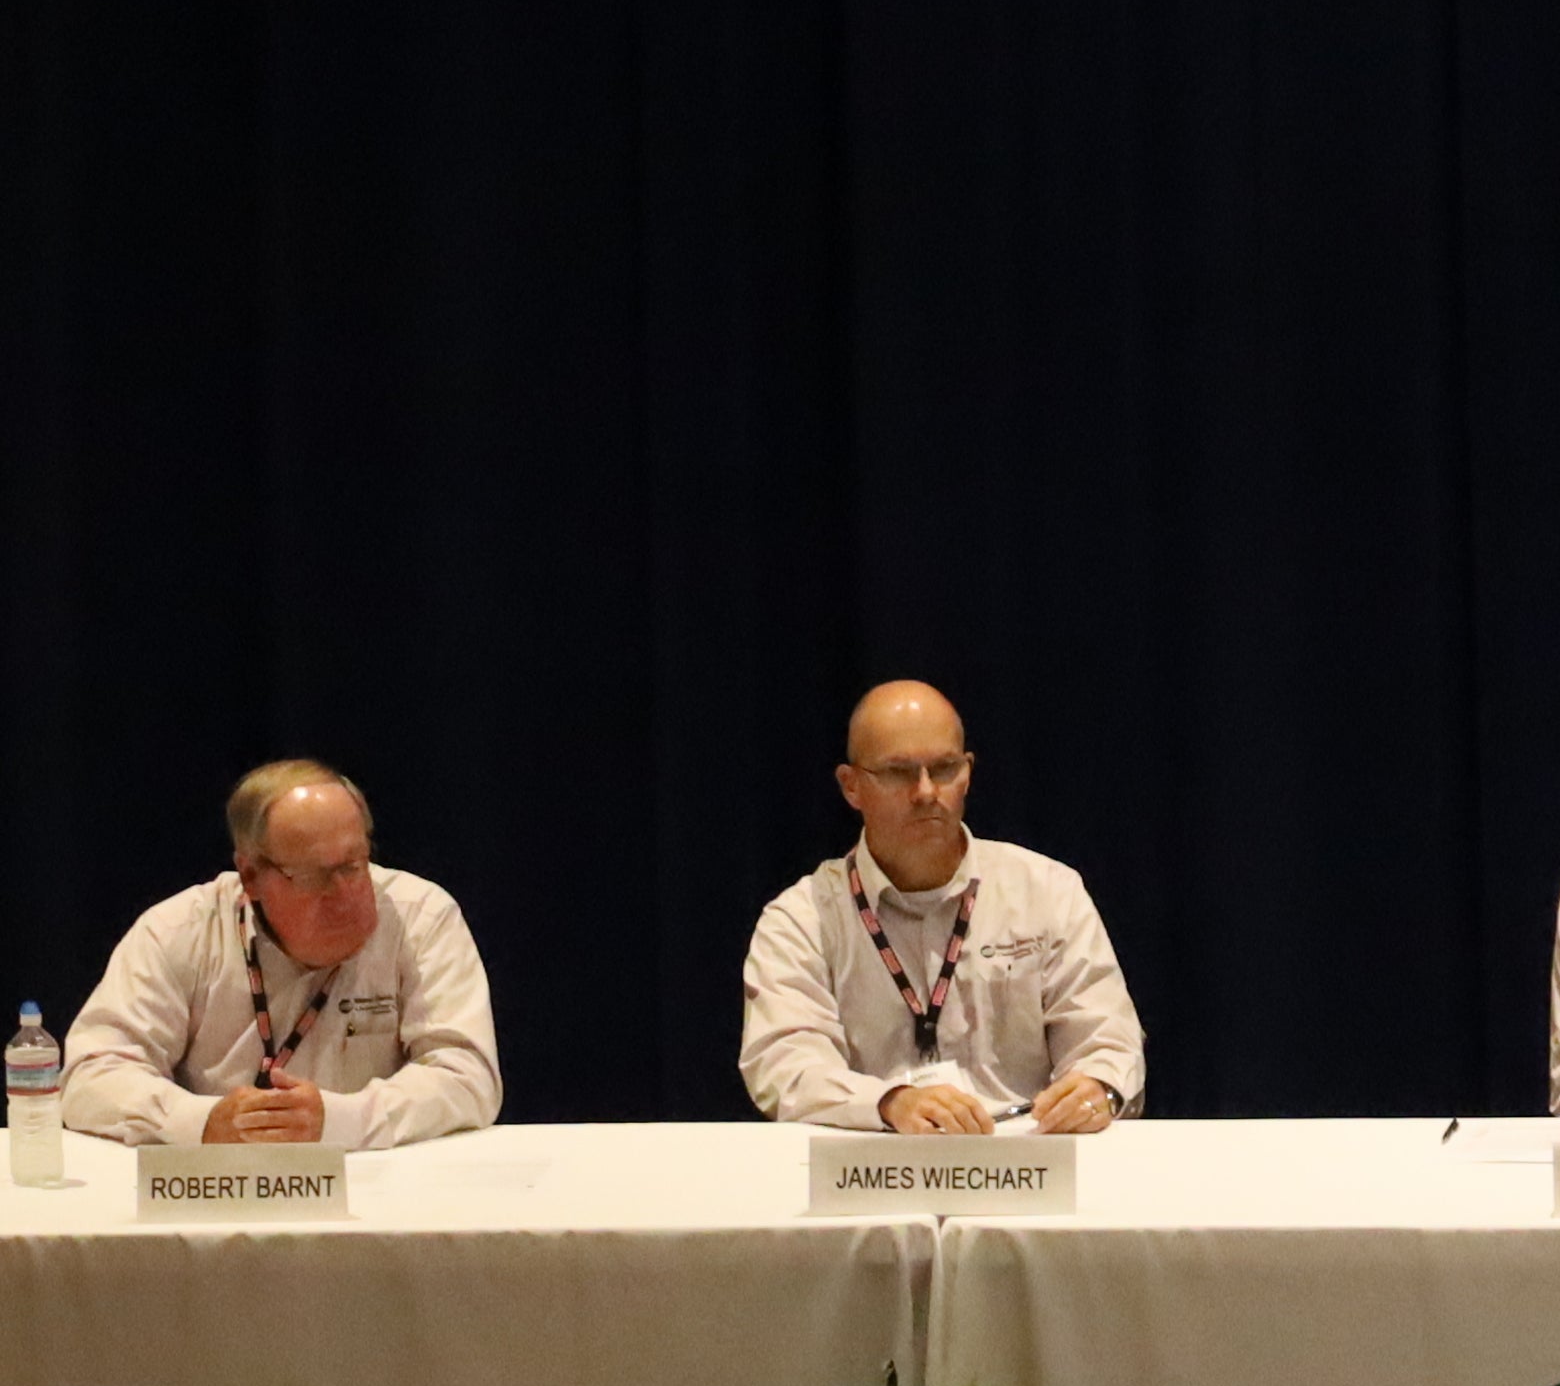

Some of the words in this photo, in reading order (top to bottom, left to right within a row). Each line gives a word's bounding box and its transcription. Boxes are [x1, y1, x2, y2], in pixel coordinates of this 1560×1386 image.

[151, 1175, 249, 1200] ROBERT
[256, 1174, 336, 1199] BARNT
[836, 1166, 915, 1190] JAMES
[921, 1166, 1048, 1190] WIECHART
